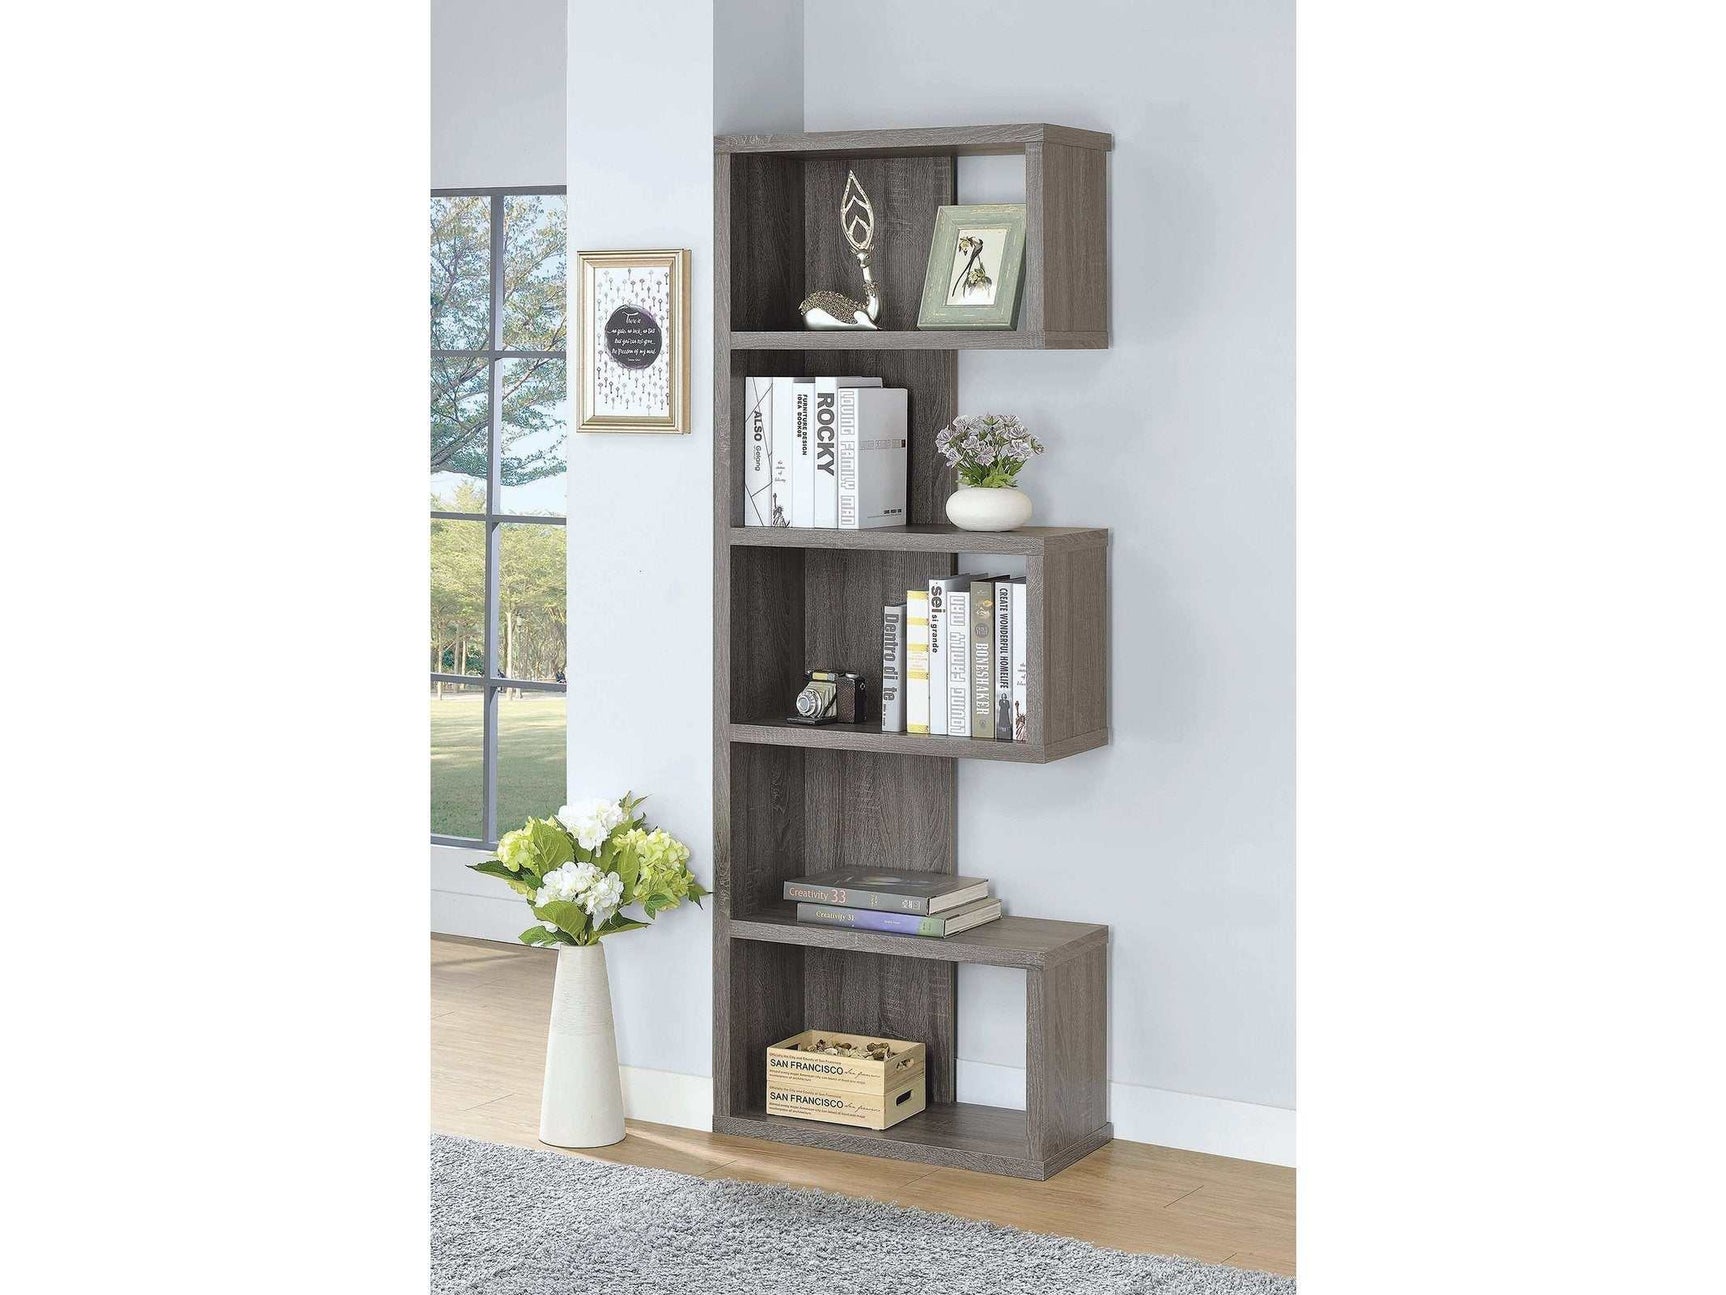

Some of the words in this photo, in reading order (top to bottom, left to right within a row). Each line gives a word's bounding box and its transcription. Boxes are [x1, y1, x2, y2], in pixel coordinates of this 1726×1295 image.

[753, 410, 763, 442] ALSO
[817, 392, 835, 476] ROCKY
[931, 585, 946, 613] sei
[999, 587, 1009, 612] CREATE
[884, 613, 899, 663] Dentro
[999, 612, 1009, 655] WONDERFUL
[884, 664, 899, 680] di
[975, 642, 990, 716] BONESHAKER
[999, 656, 1009, 689] HOMELIFE
[884, 686, 897, 702] te
[789, 887, 829, 901] Creativity
[831, 889, 847, 904] 33
[815, 910, 846, 922] Creativity
[770, 1059, 788, 1068] SAN
[790, 1061, 844, 1075] FRANCISCO
[770, 1092, 788, 1101] SAN
[790, 1094, 844, 1108] FRANCISCO
